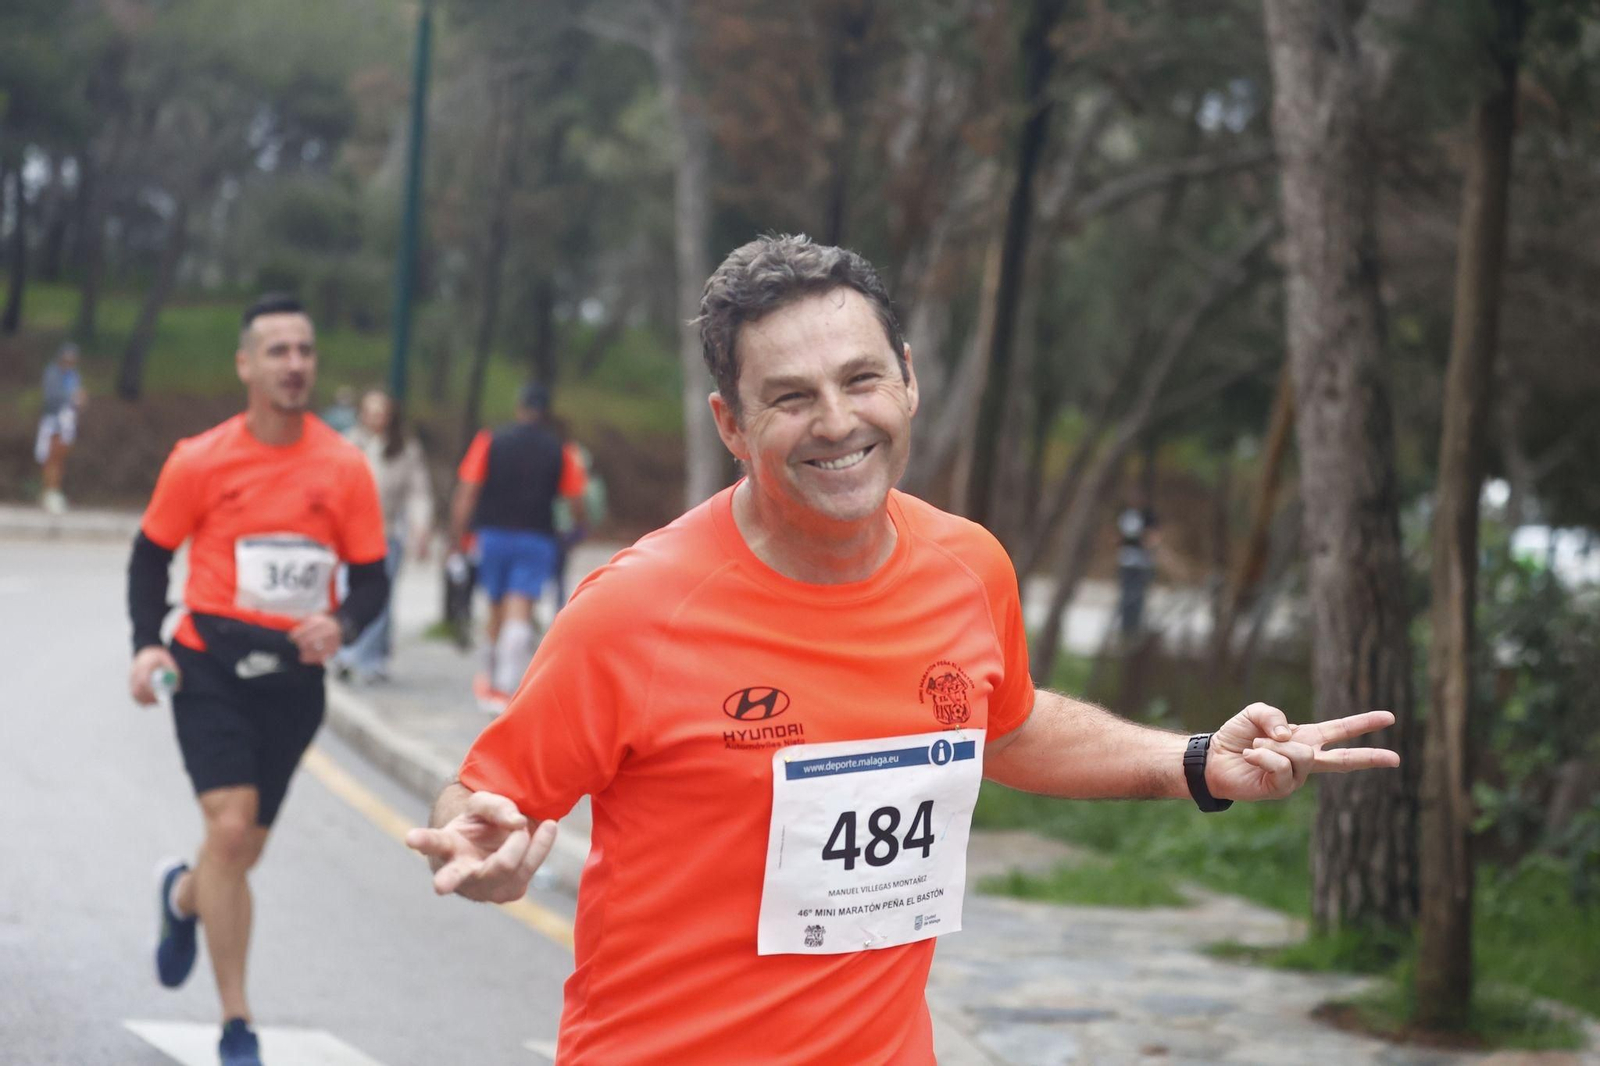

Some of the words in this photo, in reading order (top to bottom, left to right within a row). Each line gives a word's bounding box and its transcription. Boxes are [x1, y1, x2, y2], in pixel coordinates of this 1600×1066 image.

[723, 723, 804, 742] HYUNDAI
[803, 755, 899, 773] www.deporte.malaga.eu
[822, 800, 935, 870] 484
[828, 887, 859, 897] MANUEL
[860, 882, 892, 893] VILLEGAS
[892, 875, 927, 888] MONTAÑEZ
[815, 909, 836, 917] MINI
[838, 903, 881, 916] MARATÓN
[882, 898, 904, 910] PEÑA
[906, 897, 915, 906] EL
[916, 888, 944, 903] BASTÓN
